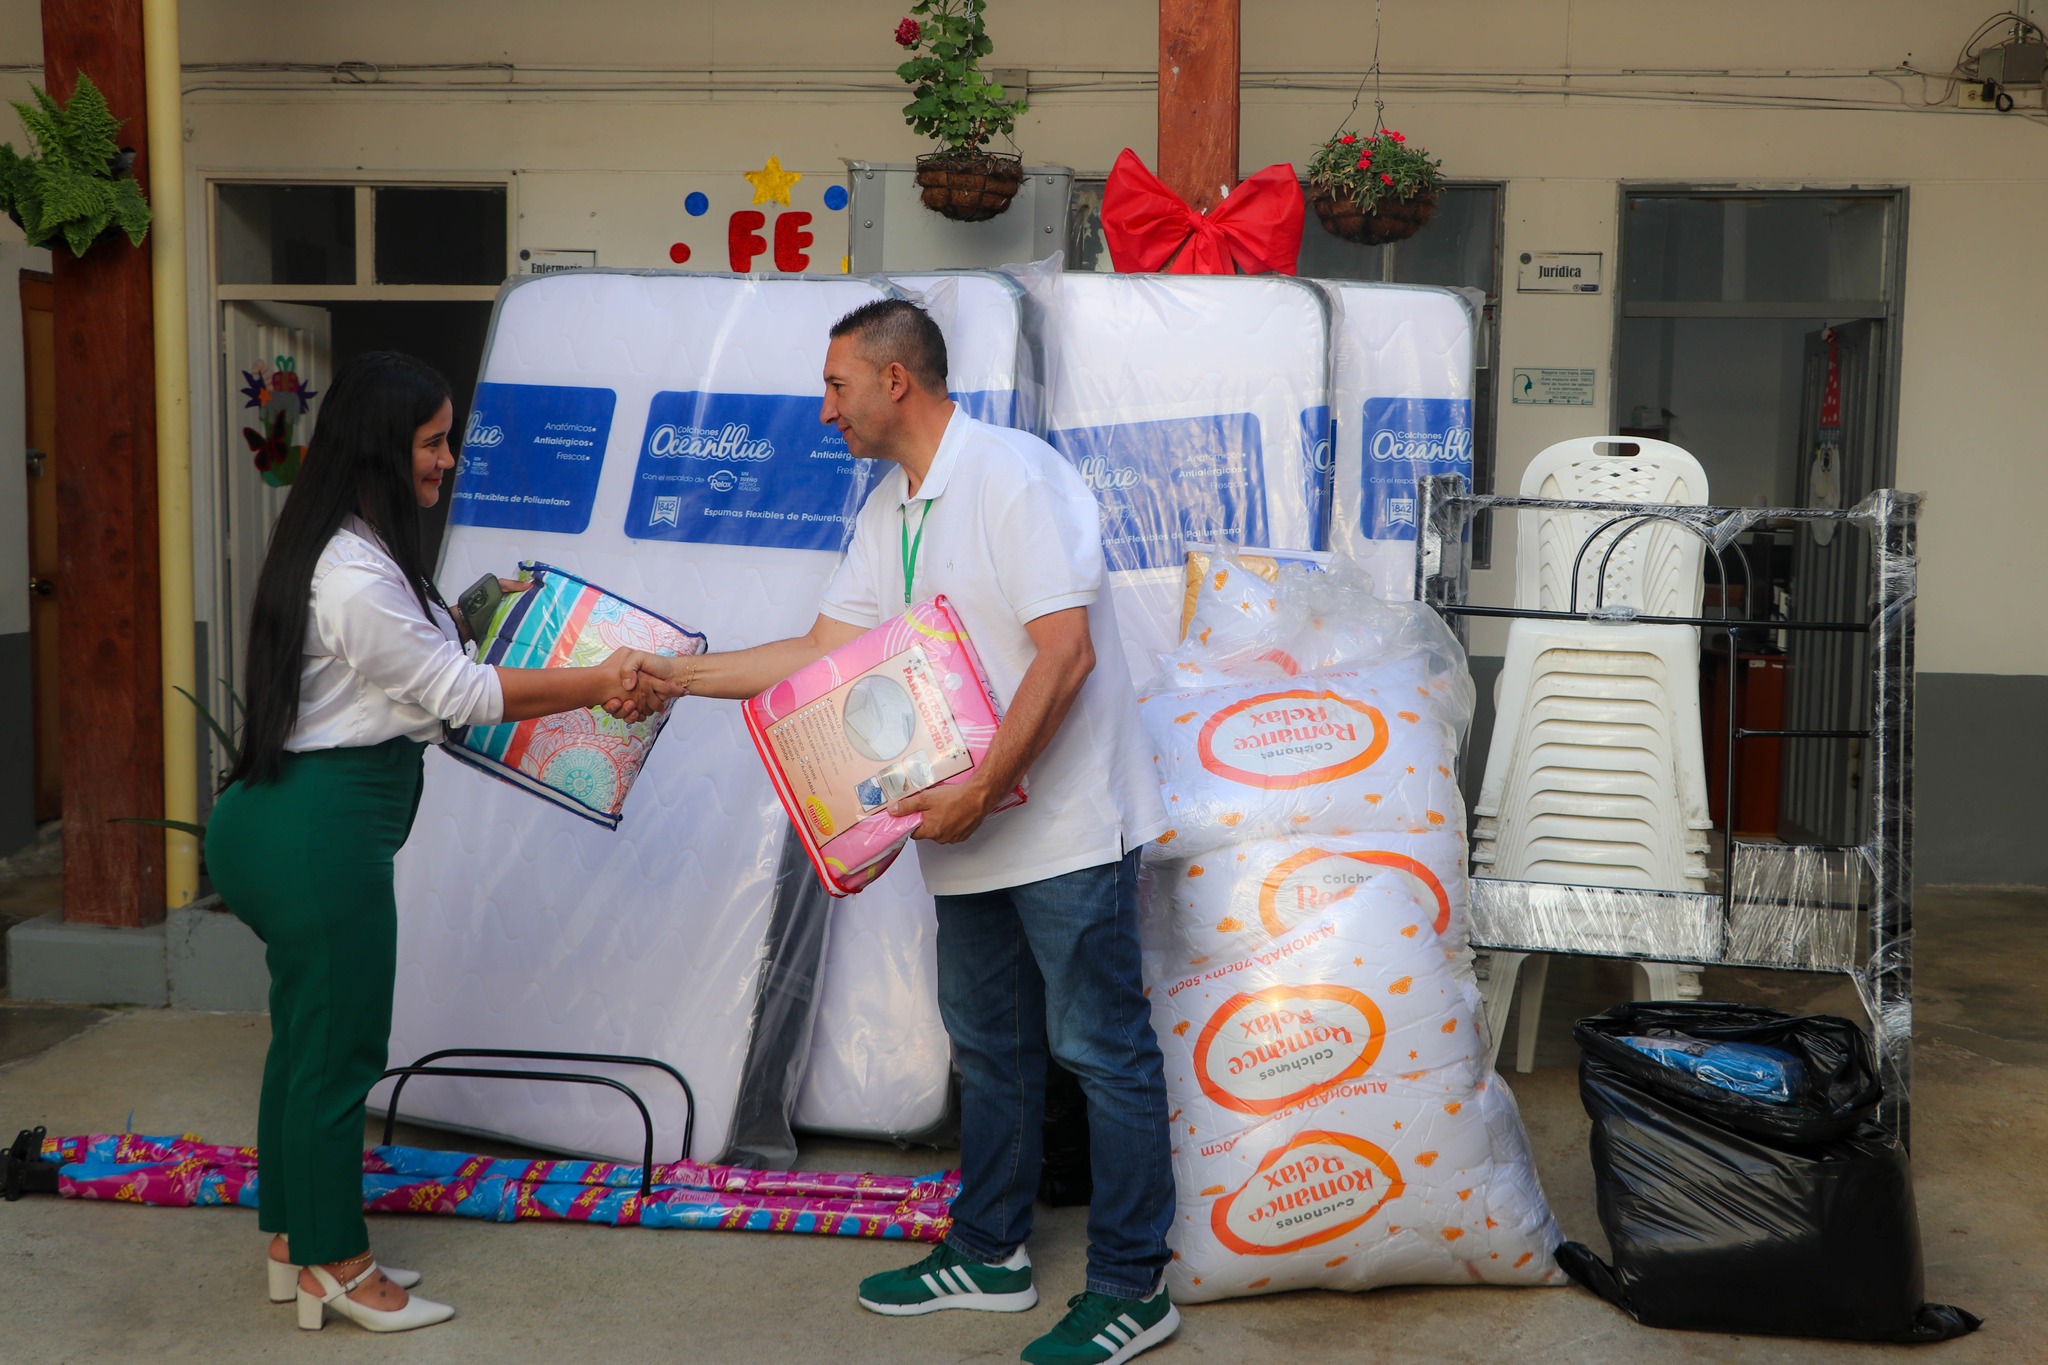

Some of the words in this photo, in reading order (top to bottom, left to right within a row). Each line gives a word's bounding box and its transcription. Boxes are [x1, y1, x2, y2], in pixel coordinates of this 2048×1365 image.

[728, 210, 814, 273] FE
[1538, 266, 1582, 278] Jurídica
[464, 411, 504, 446] lue
[544, 422, 592, 432] Anatómicos
[678, 426, 719, 436] Colchones
[1398, 431, 1442, 440] Colchones
[534, 436, 589, 448] Antialérgicos
[650, 422, 774, 462] Oceanblue
[556, 452, 586, 461] Frescos
[810, 450, 853, 461] Antialérg
[642, 472, 658, 480] Con
[1081, 455, 1140, 491] blue
[1178, 467, 1242, 478] Antialérgicos
[1394, 478, 1418, 486] respa
[710, 479, 731, 490] Relax
[474, 492, 508, 502] Flexibles
[523, 496, 570, 506] Poliuretano
[658, 502, 676, 512] 1842
[1392, 503, 1412, 513] 1842
[704, 508, 743, 518] Espumas
[746, 510, 784, 520] Flexibles
[786, 512, 800, 520] de
[1171, 532, 1183, 540] de
[904, 666, 921, 700] PARA
[829, 703, 840, 729] SENCILLO
[917, 672, 954, 744] PROTECTOR
[1249, 704, 1328, 728] Relax
[801, 719, 810, 739] MEDIDA
[809, 739, 820, 764] ESPECIAL
[1233, 722, 1357, 752] Romance
[801, 764, 815, 796] AJUSTABLE
[814, 802, 829, 829] Super
[1168, 975, 1201, 997] 50cm
[1240, 1008, 1315, 1040] Relax
[1227, 1024, 1353, 1076] Romance
[424, 1184, 446, 1212] PCK
[1248, 1168, 1374, 1223] Romance
[774, 1207, 792, 1231] ACK
[820, 1209, 836, 1234] ACK
[865, 1215, 882, 1238] ACK
